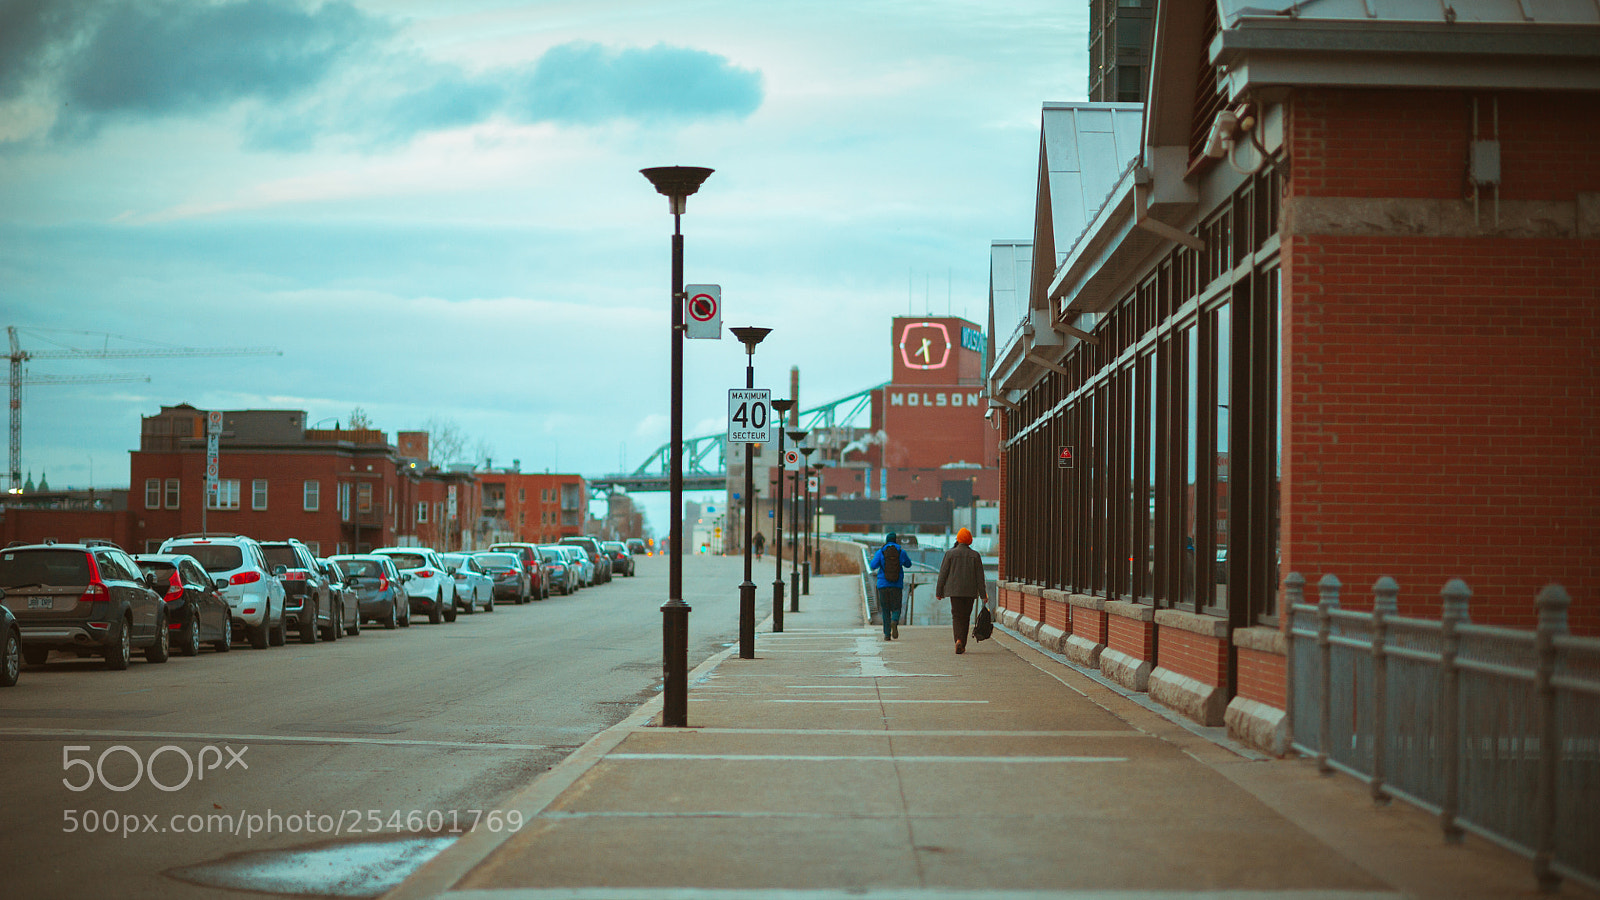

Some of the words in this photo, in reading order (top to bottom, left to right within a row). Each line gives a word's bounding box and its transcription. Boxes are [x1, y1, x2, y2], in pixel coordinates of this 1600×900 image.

[891, 393, 979, 406] MOLSON
[732, 402, 767, 429] 40
[732, 431, 766, 440] SECTEUR
